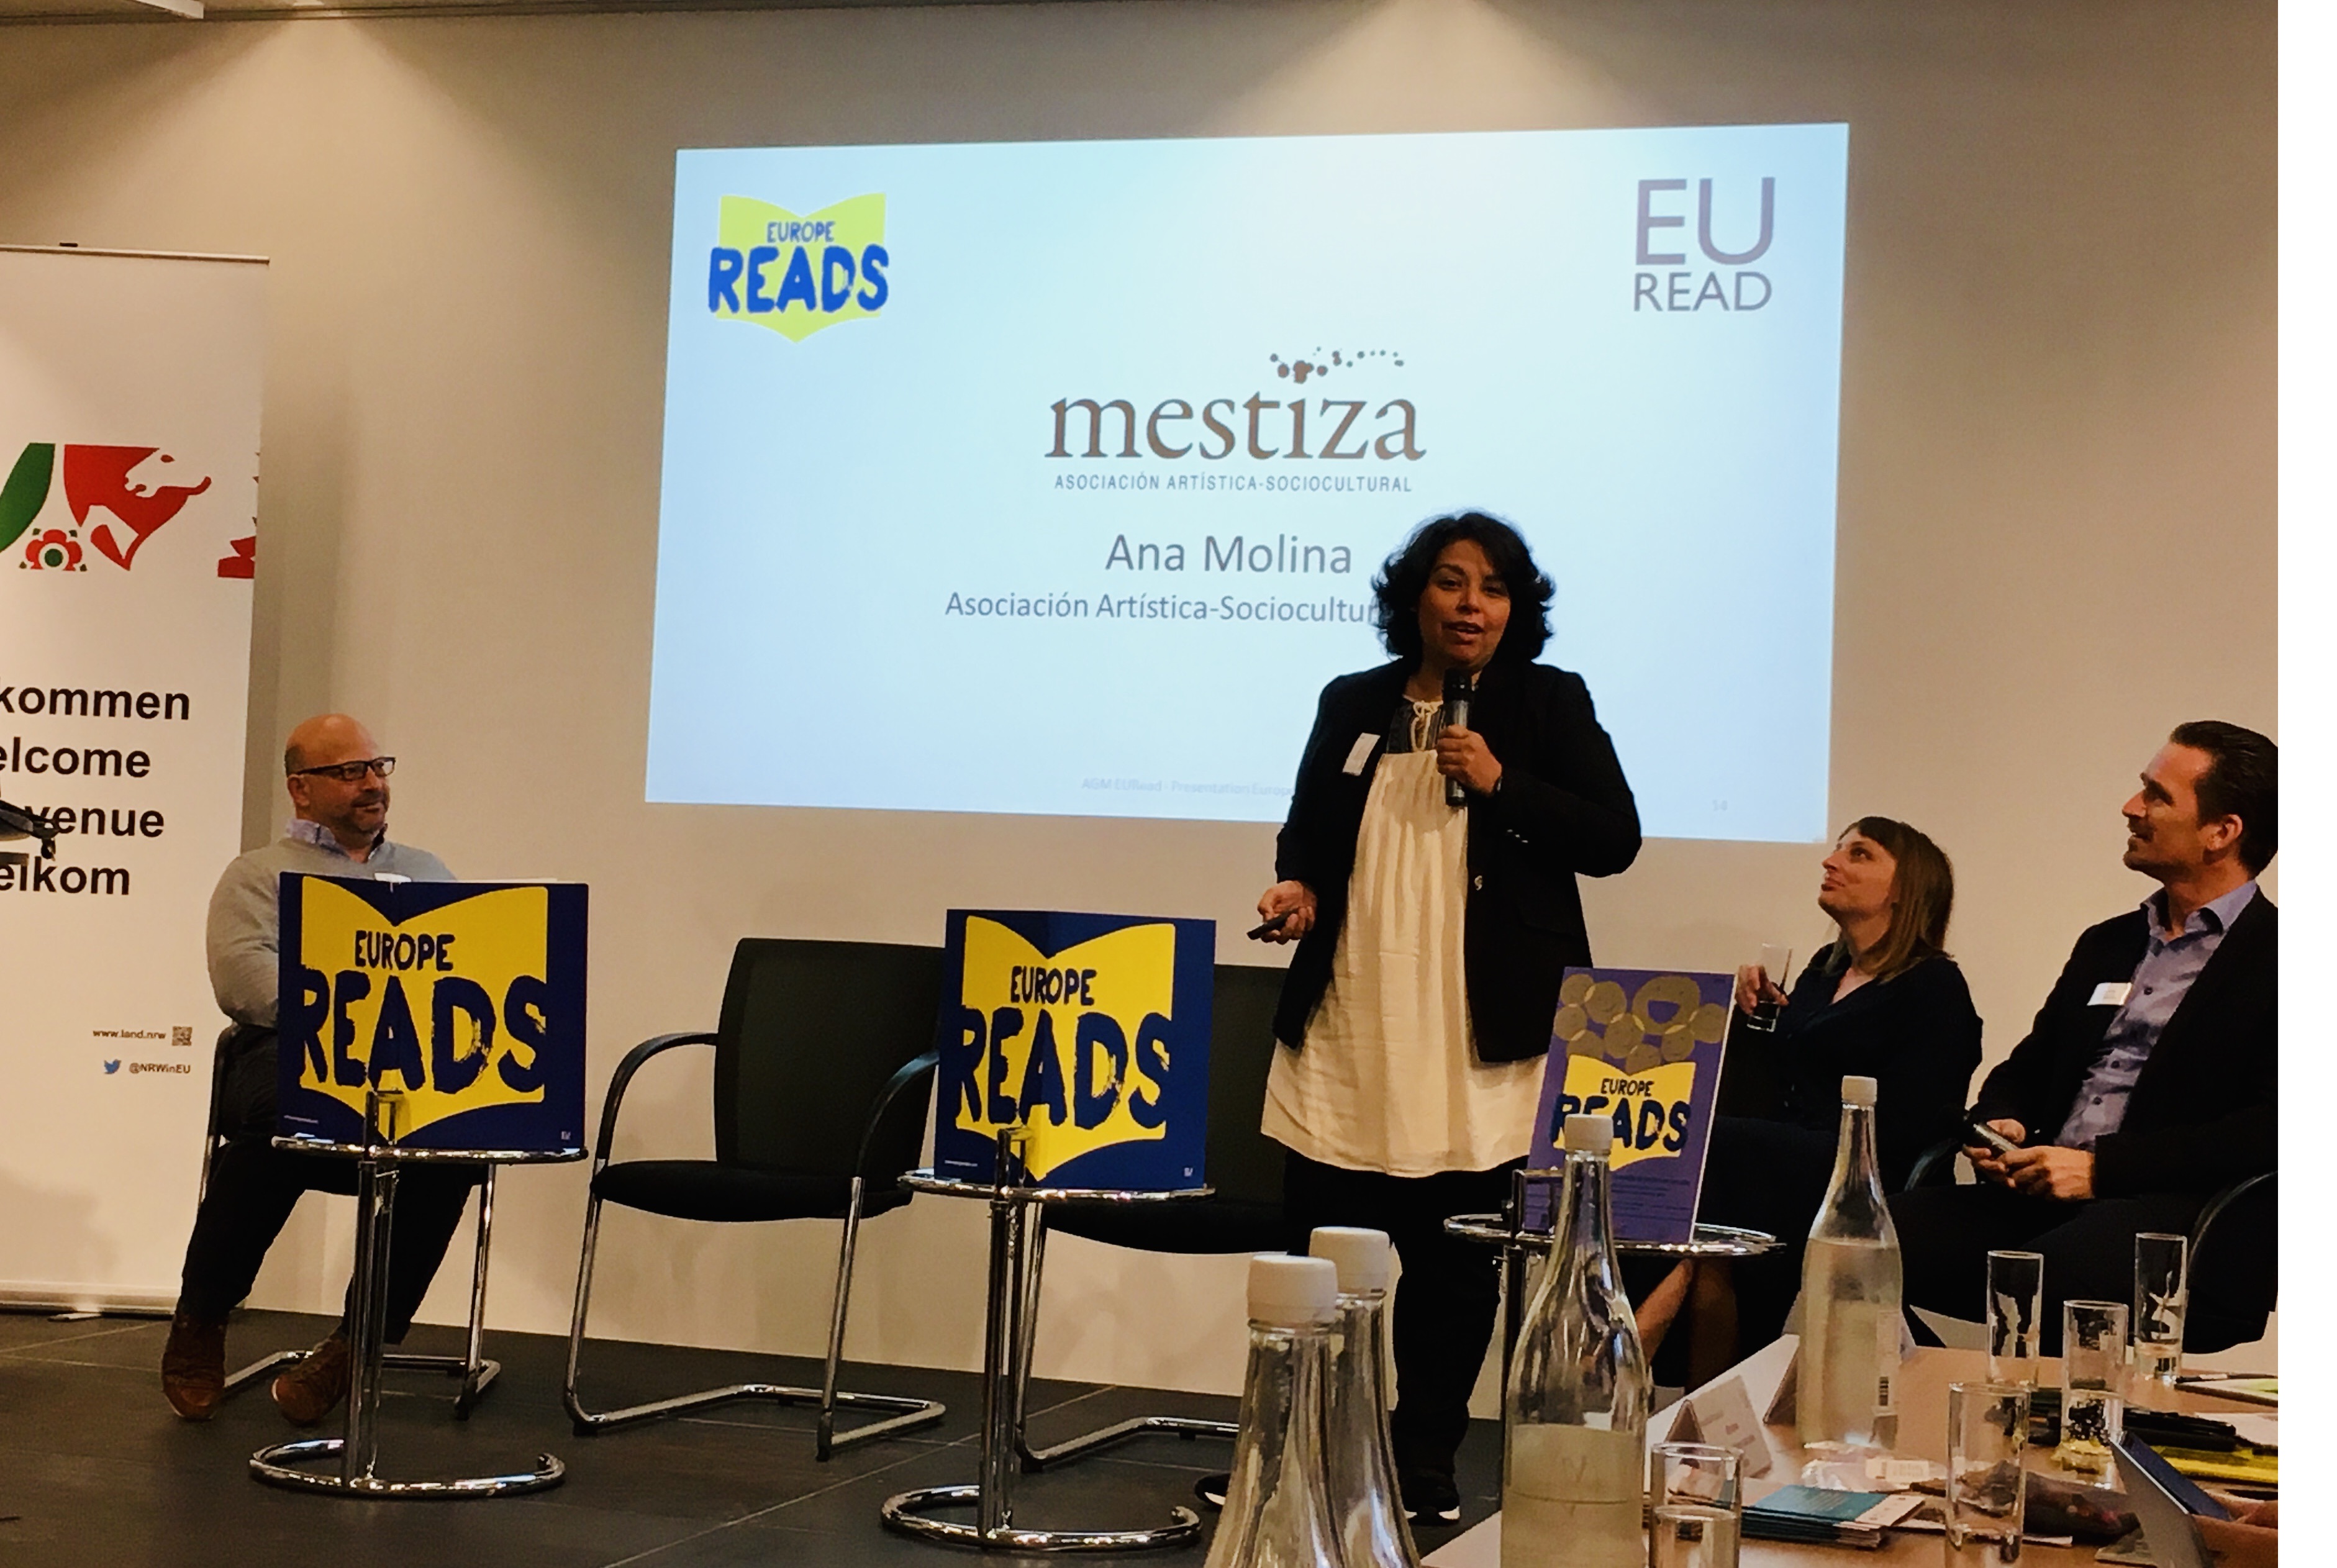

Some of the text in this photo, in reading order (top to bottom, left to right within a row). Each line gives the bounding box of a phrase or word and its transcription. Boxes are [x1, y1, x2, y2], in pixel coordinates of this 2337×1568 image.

[766, 221, 835, 243] EUROPE
[1636, 177, 1776, 265] EU
[708, 243, 889, 314] READS
[1634, 271, 1772, 312] READ
[1045, 391, 1427, 461] mestiza
[1055, 471, 1412, 492] ASOCIACIÓN ARTÍSTICA-SOCIOCULTURAL
[1105, 534, 1352, 574] Ana Molina
[945, 591, 1088, 618] Asociación
[0, 736, 151, 777] lcome
[1082, 778, 1111, 789] AGM
[1171, 781, 1250, 794] Presentation
[355, 930, 455, 971] EUROPE
[1010, 965, 1097, 1005] EUROPE
[298, 963, 547, 1094] READS
[129, 1062, 191, 1074] @NRWinEU
[956, 1005, 1172, 1130] READS
[1600, 1078, 1654, 1097] EUROPE
